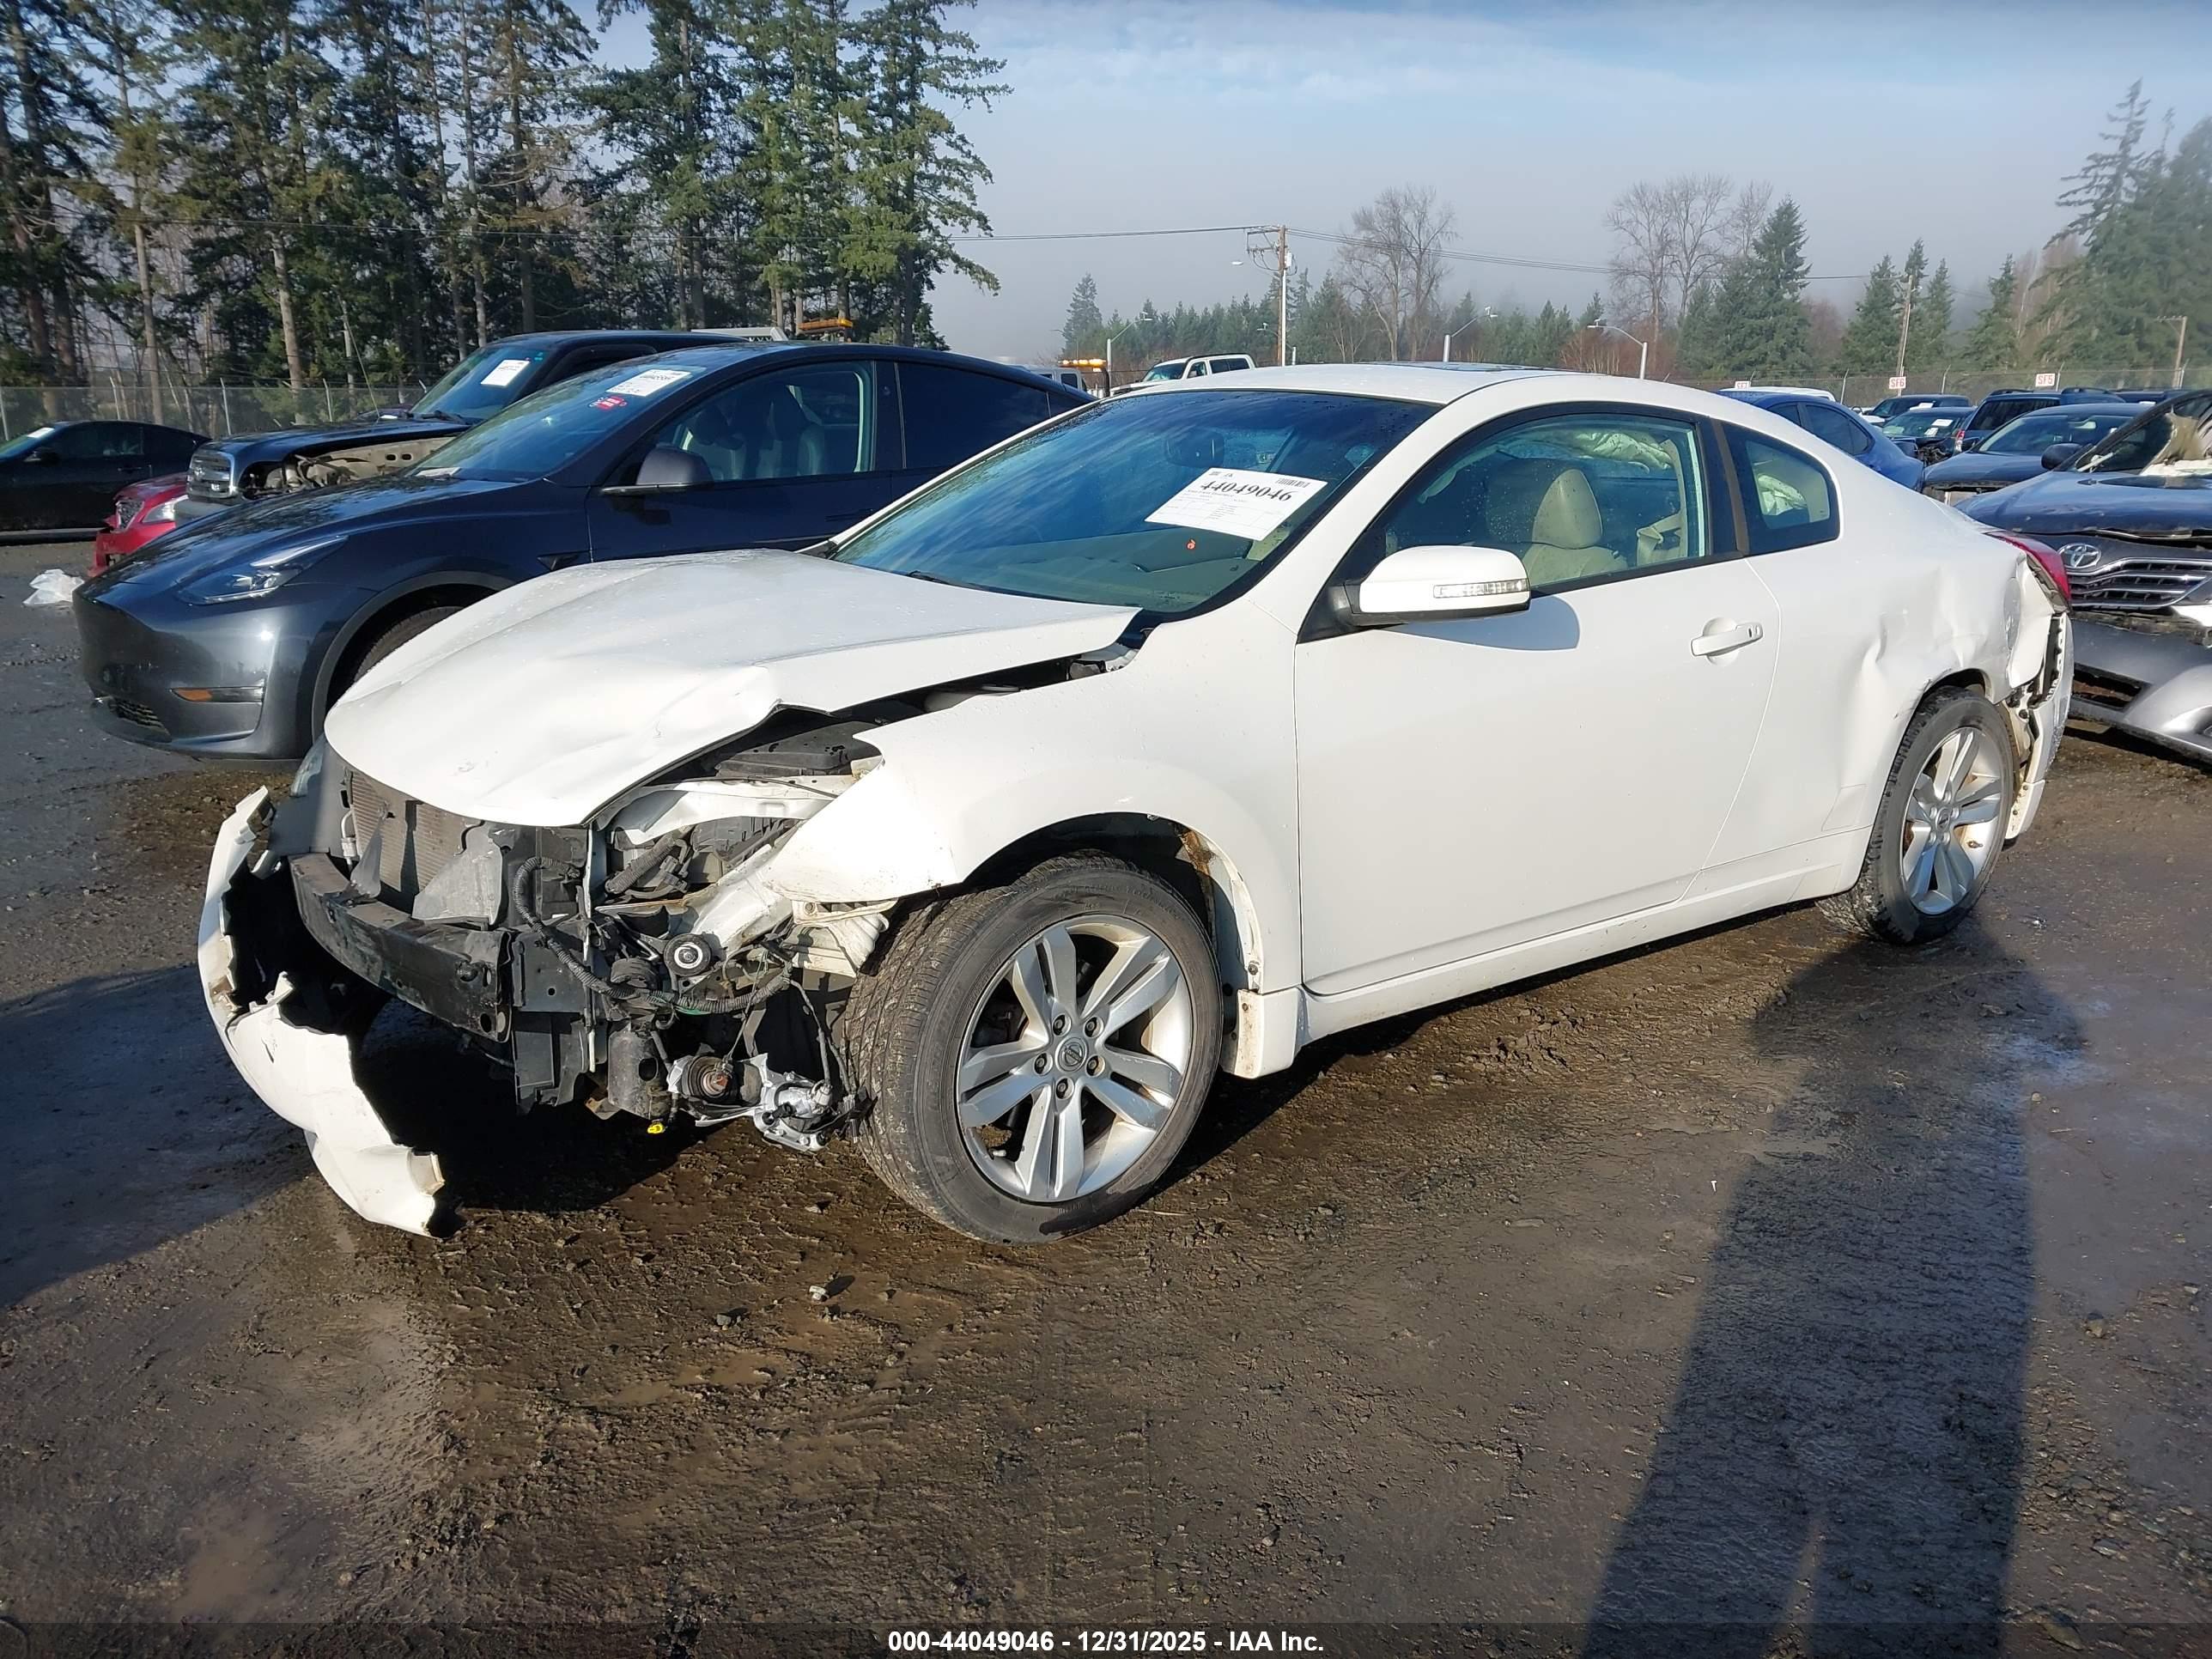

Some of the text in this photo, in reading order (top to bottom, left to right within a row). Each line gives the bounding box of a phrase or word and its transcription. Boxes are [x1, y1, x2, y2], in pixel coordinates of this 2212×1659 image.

[1891, 378, 1905, 388] SF6
[2038, 374, 2053, 386] SF5
[1200, 480, 1298, 501] 44049046
